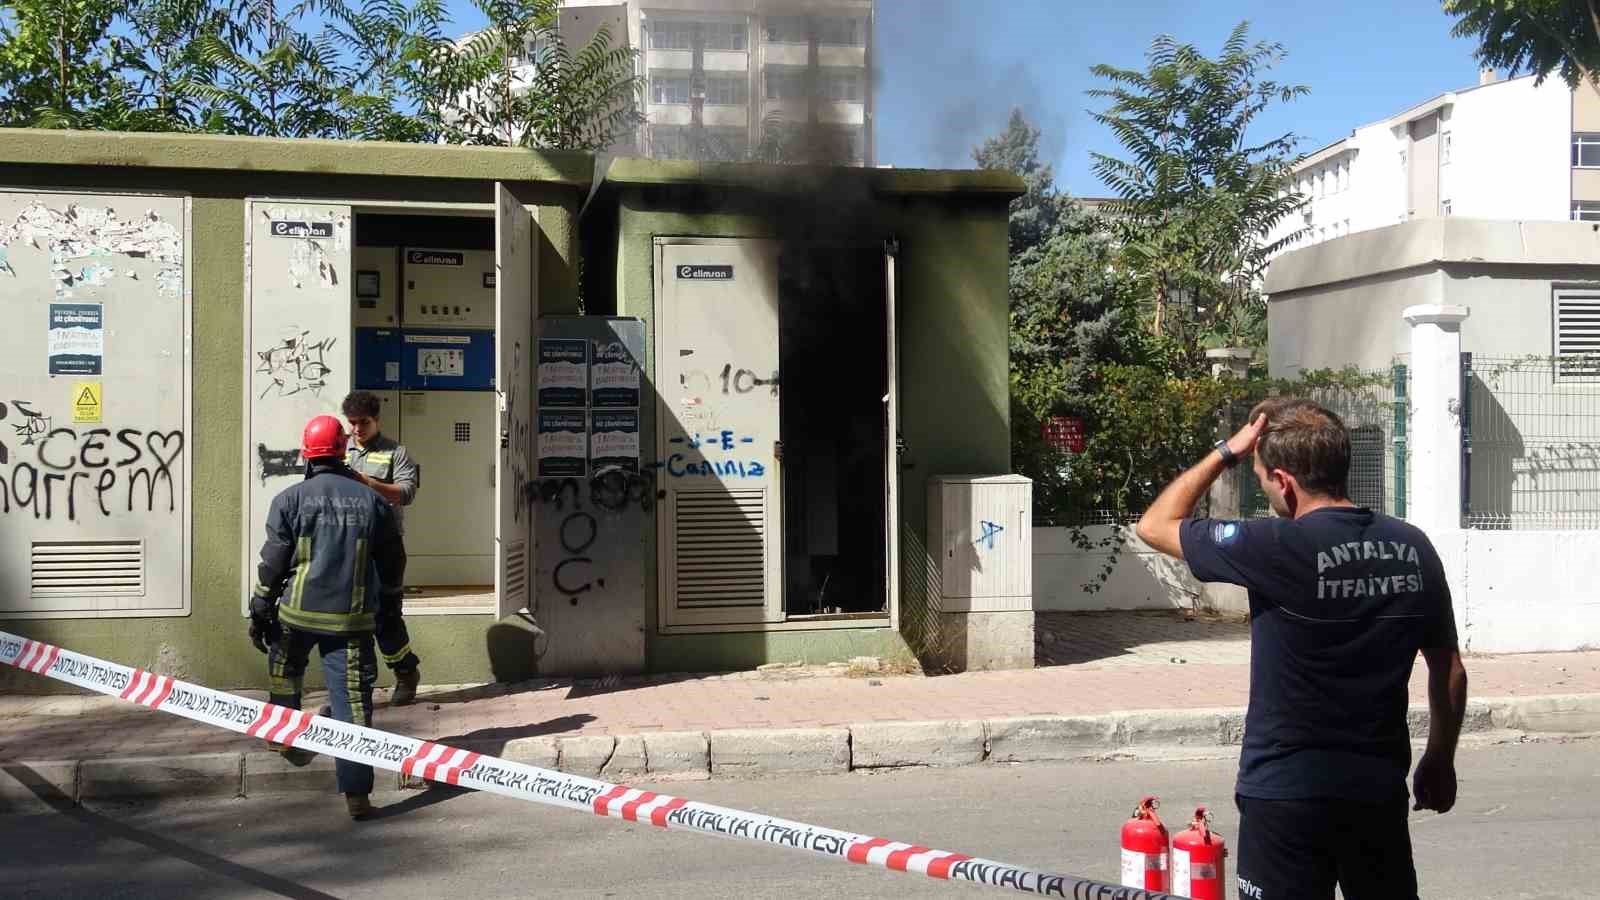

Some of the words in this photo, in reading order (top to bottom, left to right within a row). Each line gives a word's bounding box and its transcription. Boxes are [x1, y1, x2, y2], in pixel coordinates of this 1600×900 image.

[38, 428, 141, 470] CES
[1317, 541, 1420, 574] ANTALYA
[1317, 573, 1424, 599] İTFAİYESİ
[51, 655, 89, 679] ANTALYA
[88, 662, 130, 690] İTFAİYESİ
[160, 687, 209, 712] ANTALYA
[208, 695, 258, 725] İTFAİYESİ
[298, 723, 345, 750] ANTALYA
[341, 731, 414, 762] İTFAİYESİ
[461, 763, 529, 789] ANTALYA
[669, 806, 754, 836] ANTALYA
